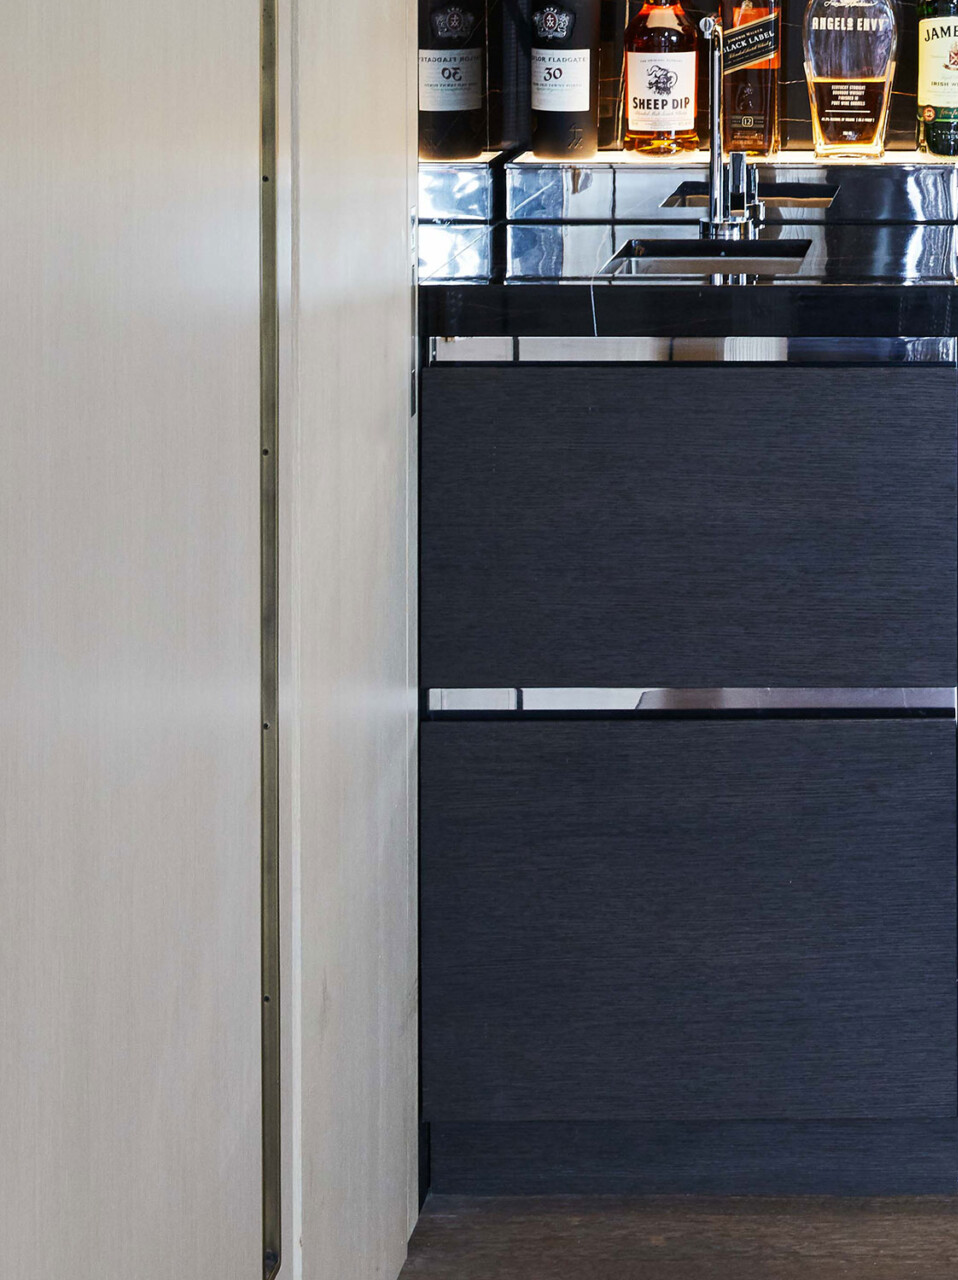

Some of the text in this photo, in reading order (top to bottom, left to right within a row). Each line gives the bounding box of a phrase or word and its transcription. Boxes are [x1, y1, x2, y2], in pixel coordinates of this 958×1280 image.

[857, 17, 885, 31] ENVY
[749, 30, 775, 45] LABEL
[543, 67, 563, 82] 30
[632, 97, 690, 110] SHEEP DIP
